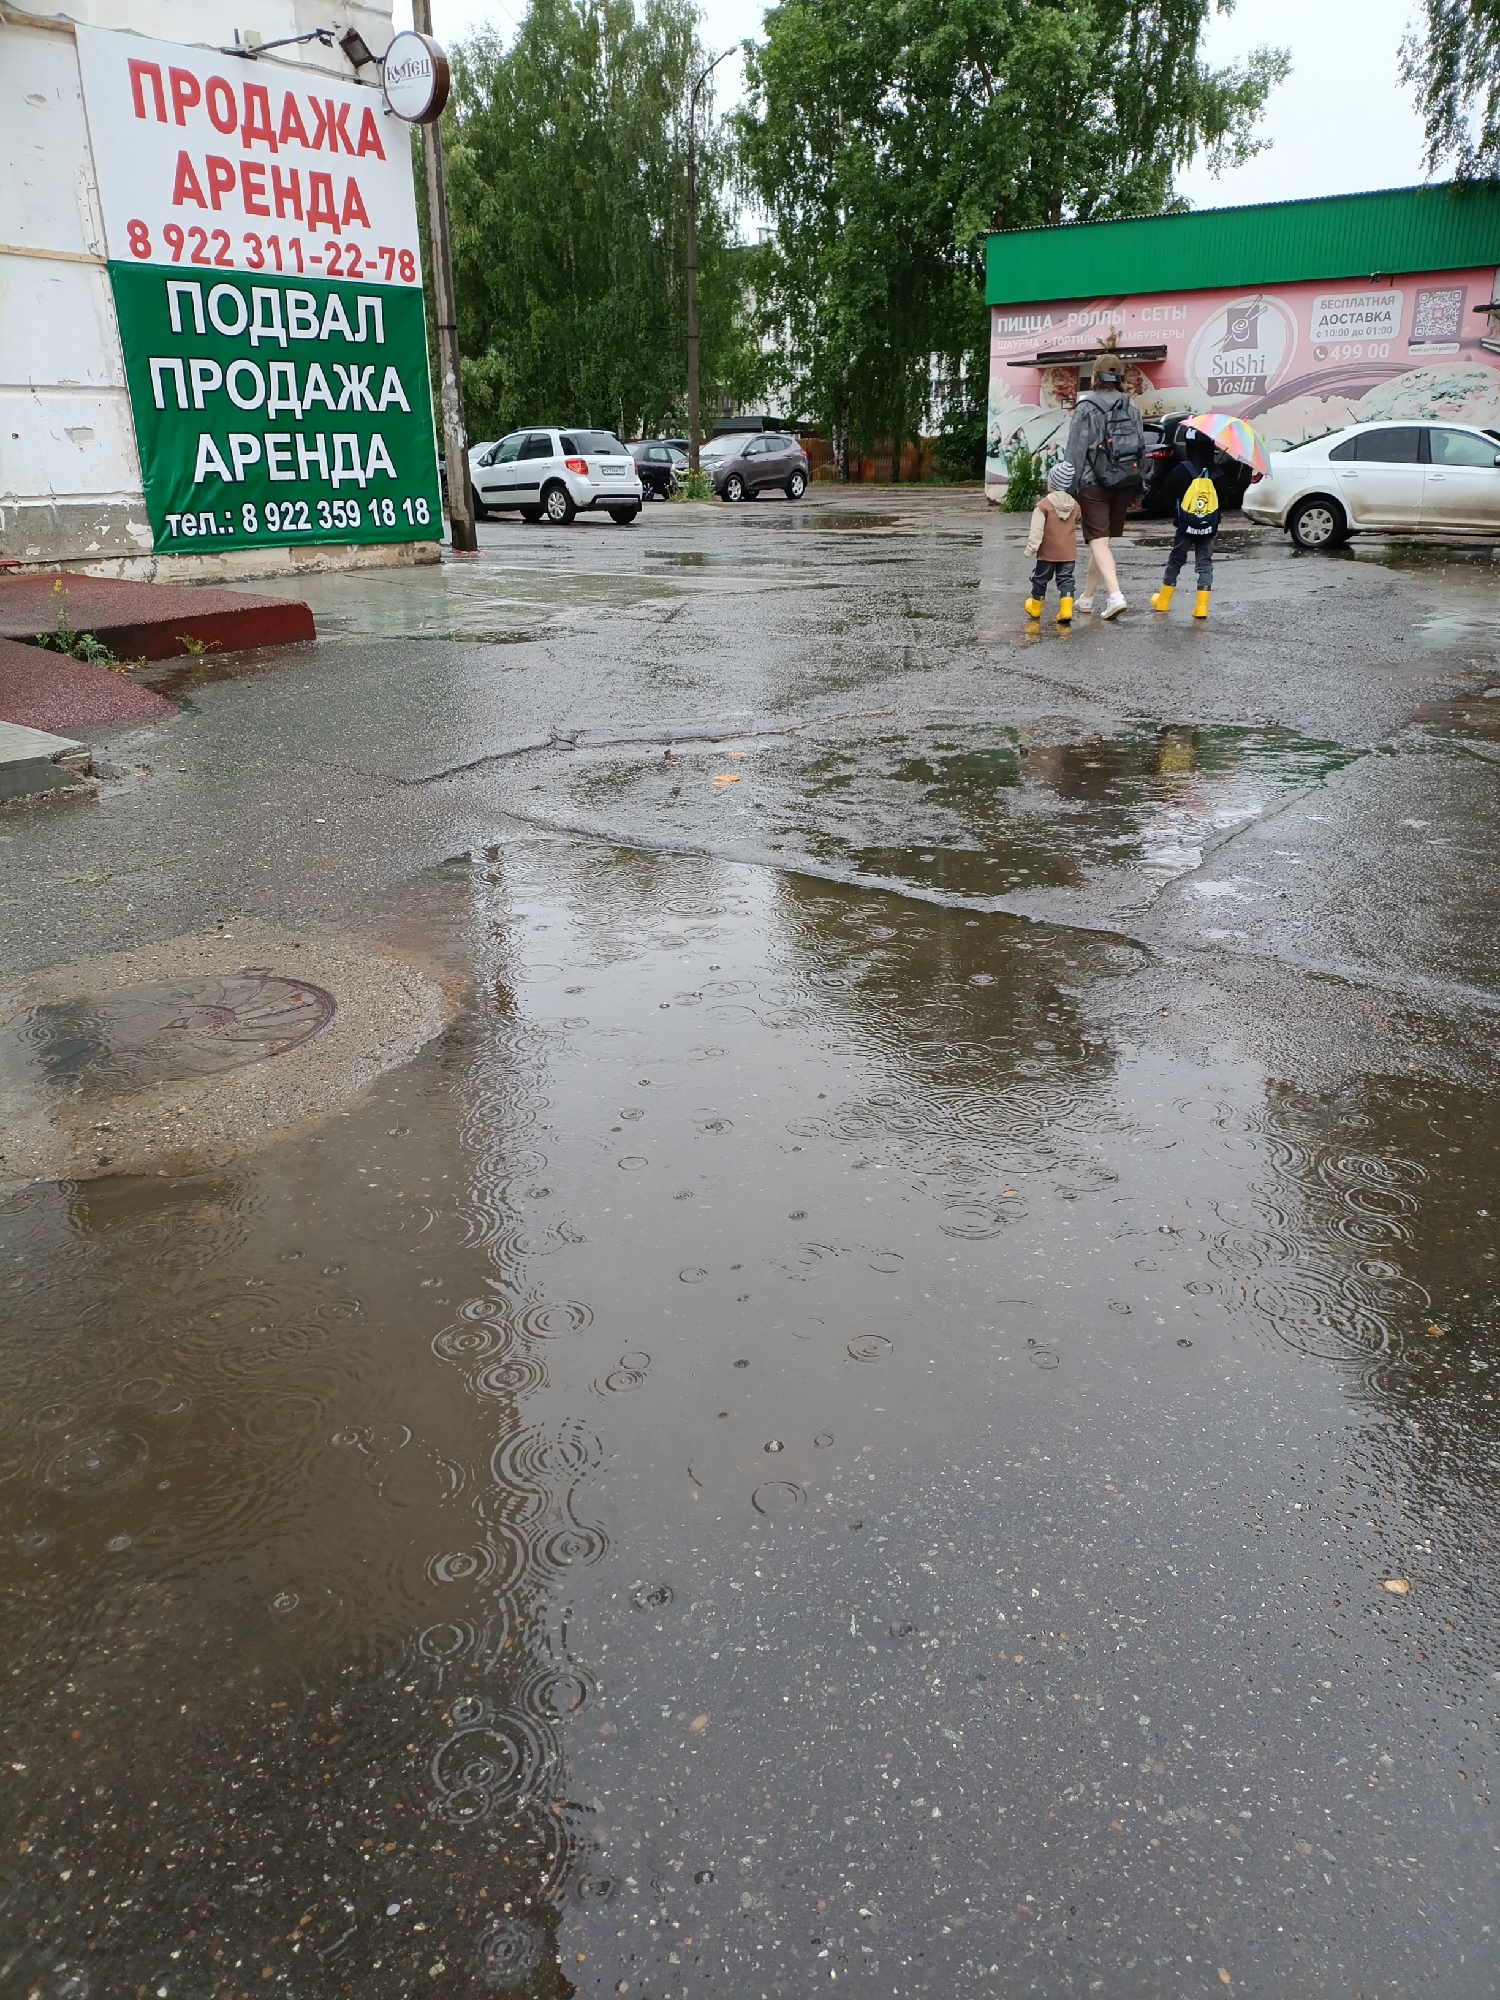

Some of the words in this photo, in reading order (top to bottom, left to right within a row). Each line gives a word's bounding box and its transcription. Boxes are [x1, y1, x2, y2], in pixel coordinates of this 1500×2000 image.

[127, 57, 387, 161] ПРОДАЖА
[172, 150, 371, 235] АРЕНДА
[126, 218, 152, 259] 8
[162, 223, 234, 267] 922
[242, 232, 416, 283] 311-22-78
[166, 280, 385, 348] ПОДВАЛ
[997, 314, 1053, 333] ПИЦЦА
[1067, 309, 1126, 328] РОЛЛЫ
[1141, 305, 1187, 322] СЕТЫ
[1319, 311, 1392, 327] ДОСТАВКА
[1320, 295, 1395, 310] БЕСПЛАТНАЯ
[997, 338, 1040, 350] ШАУРМА
[1324, 328, 1350, 338] 10:00
[1351, 329, 1363, 338] до
[1366, 326, 1393, 336] 01:00
[1330, 344, 1363, 360] 499
[1367, 343, 1390, 359] 00
[149, 357, 412, 420] ПРОДАЖА
[1215, 376, 1257, 394] Yoshi
[193, 433, 398, 489] АРЕНДА
[165, 512, 234, 538] тел.:
[241, 502, 258, 533] 8
[264, 501, 312, 532] 922
[318, 500, 361, 529] 359
[368, 498, 396, 527] 18
[402, 497, 431, 526] 18
